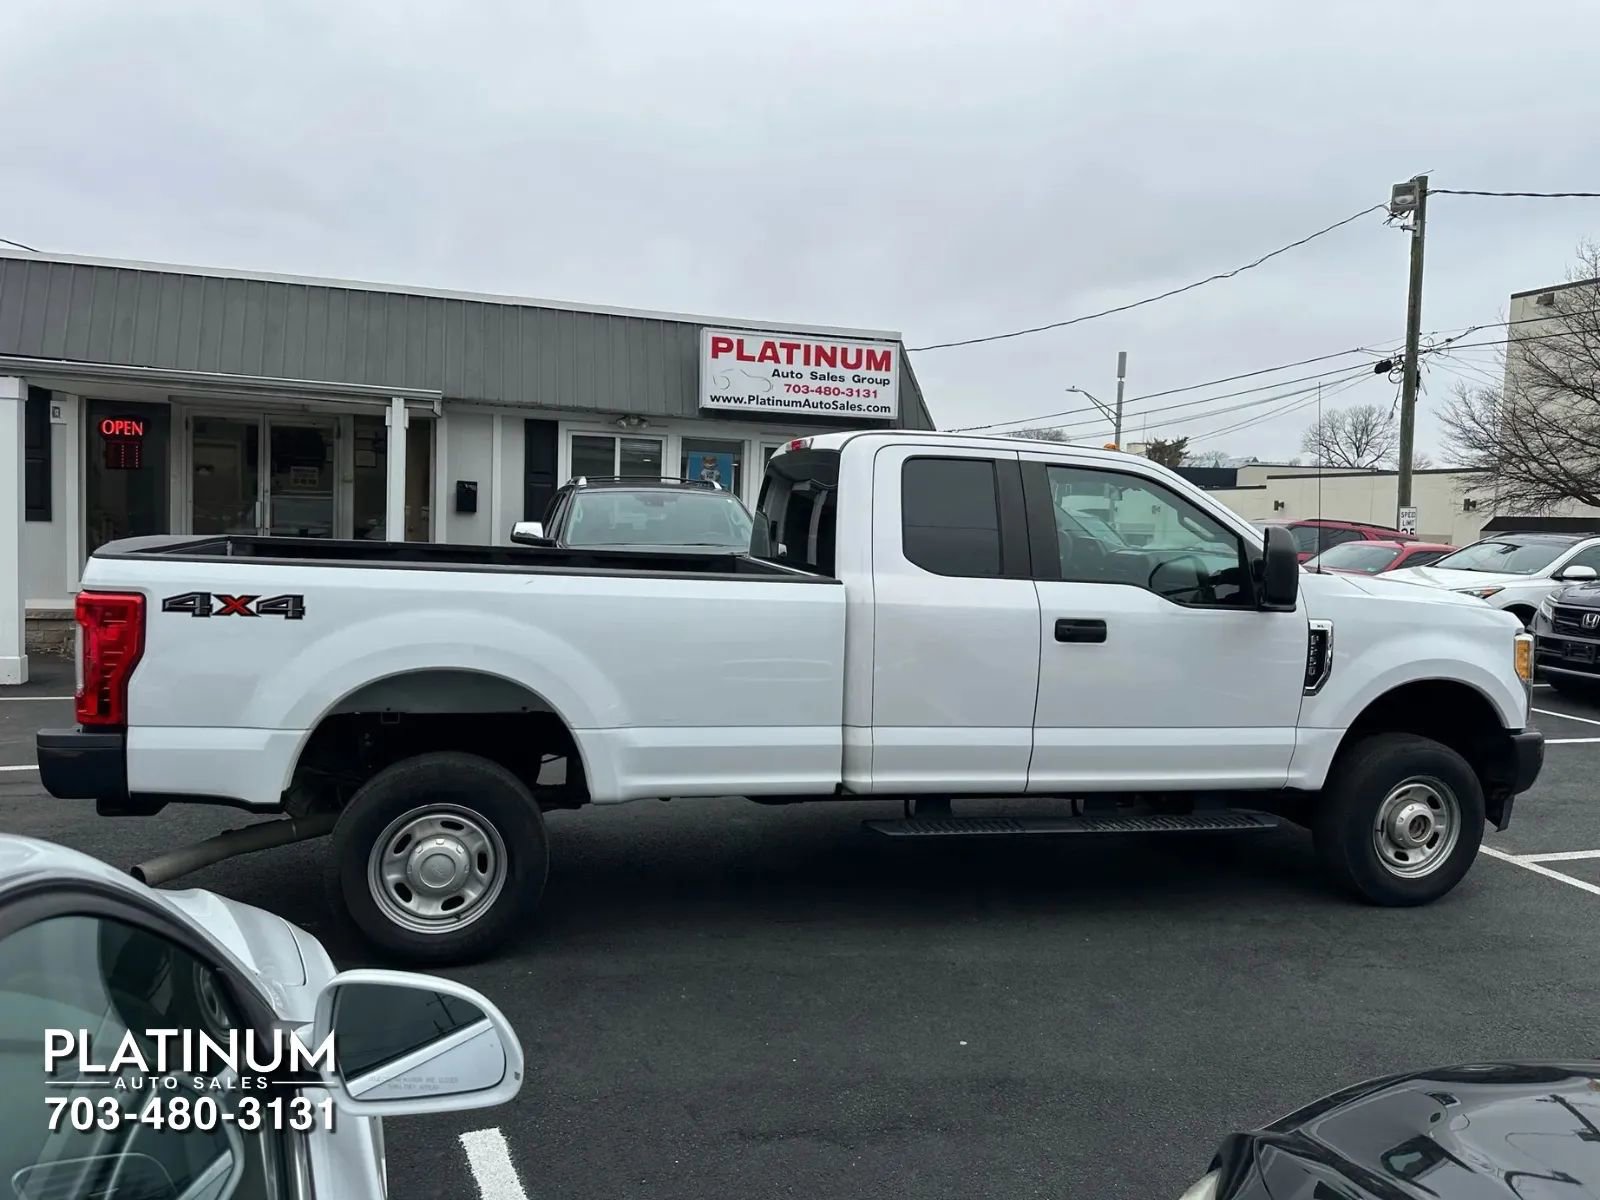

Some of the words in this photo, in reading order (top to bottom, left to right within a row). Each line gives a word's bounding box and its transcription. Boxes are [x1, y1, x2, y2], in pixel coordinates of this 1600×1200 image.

[711, 336, 892, 372] PLATINUM
[771, 368, 803, 380] Auto
[810, 371, 846, 383] Sales
[852, 374, 891, 387] Group
[783, 383, 878, 399] 703-480-3131
[710, 395, 891, 414] www.PlatinumAutoSales.com
[101, 419, 144, 436] OPEN
[1401, 511, 1416, 519] SPEED
